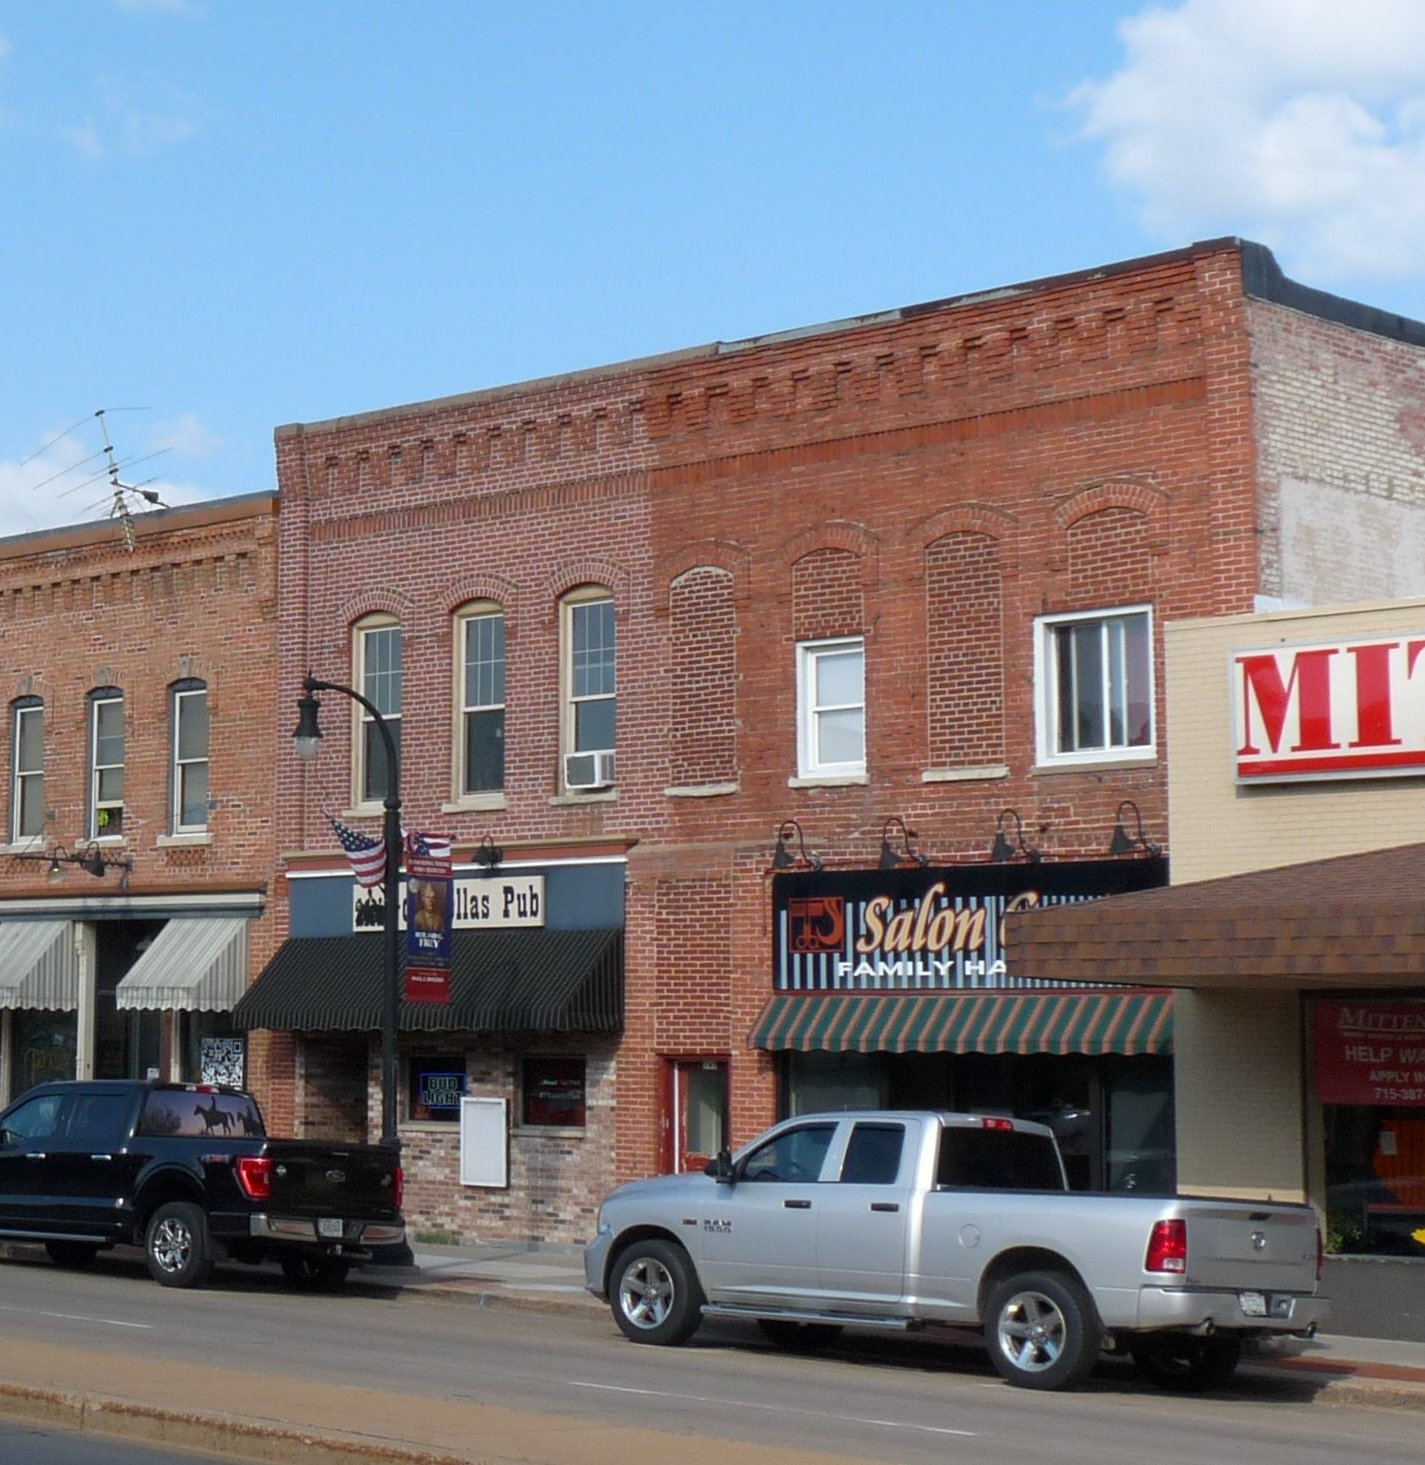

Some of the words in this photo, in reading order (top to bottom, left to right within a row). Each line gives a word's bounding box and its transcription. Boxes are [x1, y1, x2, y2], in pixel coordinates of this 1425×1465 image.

[502, 885, 539, 919] Pub
[856, 882, 986, 953] Salon
[838, 960, 954, 977] FAMILY
[965, 960, 1007, 976] HA
[1345, 1045, 1393, 1062] HELP
[1399, 1047, 1425, 1063] WA
[428, 1076, 458, 1091] BUD
[1369, 1070, 1410, 1083] APPLY
[423, 1091, 462, 1105] LIGHT
[1374, 1087, 1425, 1101] 715-387-
